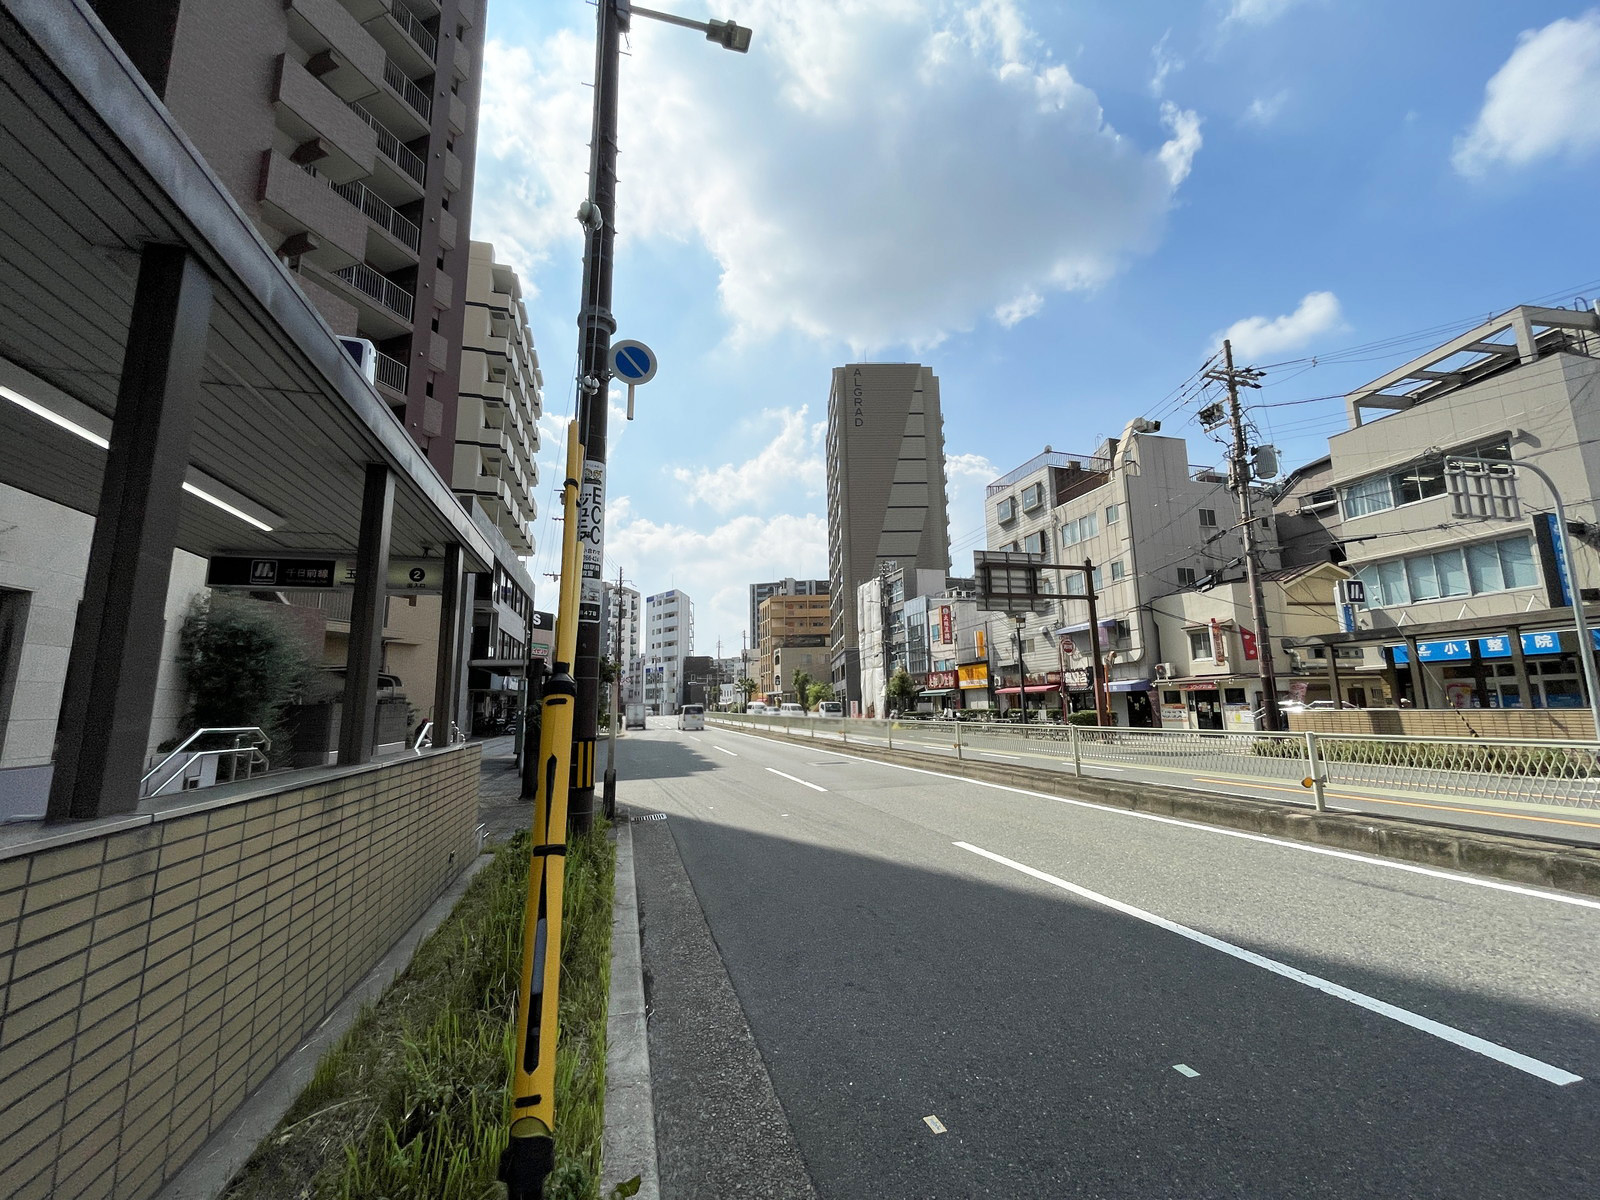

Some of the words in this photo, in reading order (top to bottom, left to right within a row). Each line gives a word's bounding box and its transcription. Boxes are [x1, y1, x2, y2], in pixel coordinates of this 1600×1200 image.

[853, 368, 864, 427] ALGRAD
[590, 486, 602, 545] ECC
[533, 613, 541, 626] S
